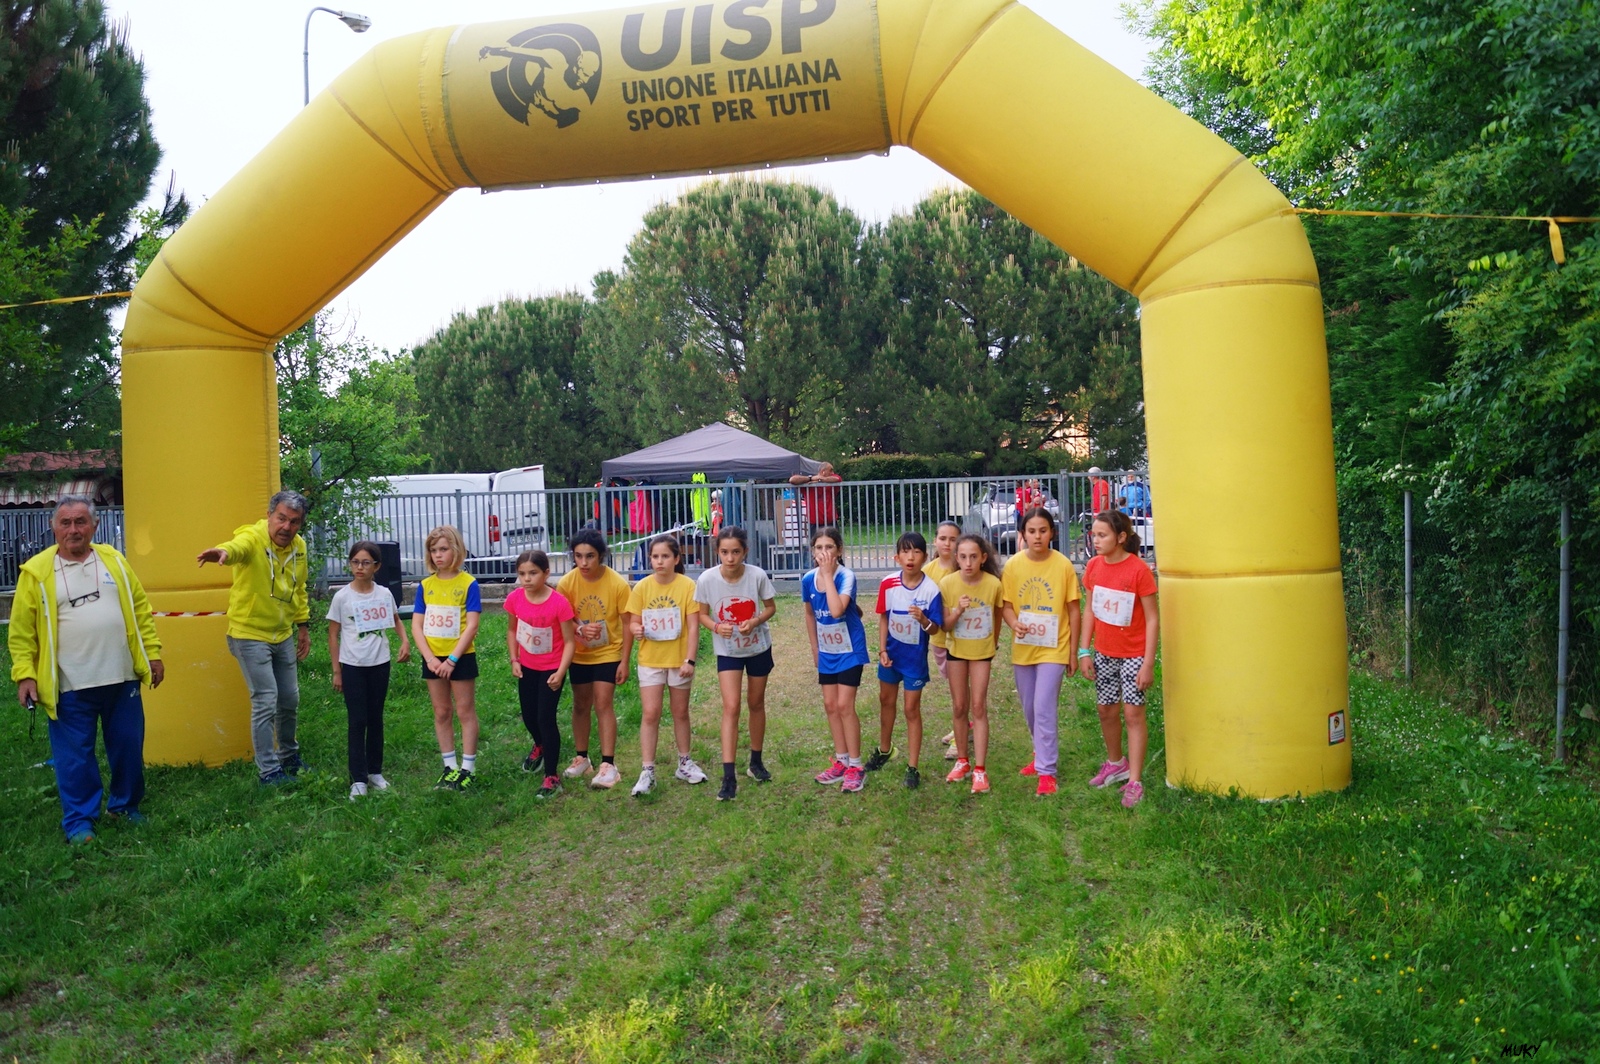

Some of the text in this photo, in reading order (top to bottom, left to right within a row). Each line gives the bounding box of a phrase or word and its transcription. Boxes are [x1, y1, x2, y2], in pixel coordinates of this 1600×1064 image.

[620, 0, 837, 72] UISP
[621, 58, 842, 105] UNIONE ITALIANA
[626, 89, 831, 132] SPORT PER TUTTI
[361, 606, 387, 622] 330
[1103, 599, 1120, 615] 41
[428, 614, 454, 628] 335
[650, 617, 675, 632] 311
[964, 617, 983, 631] 72
[1028, 622, 1047, 637] 69
[525, 632, 542, 647] 76
[734, 633, 760, 649] 124
[821, 632, 844, 645] 119
